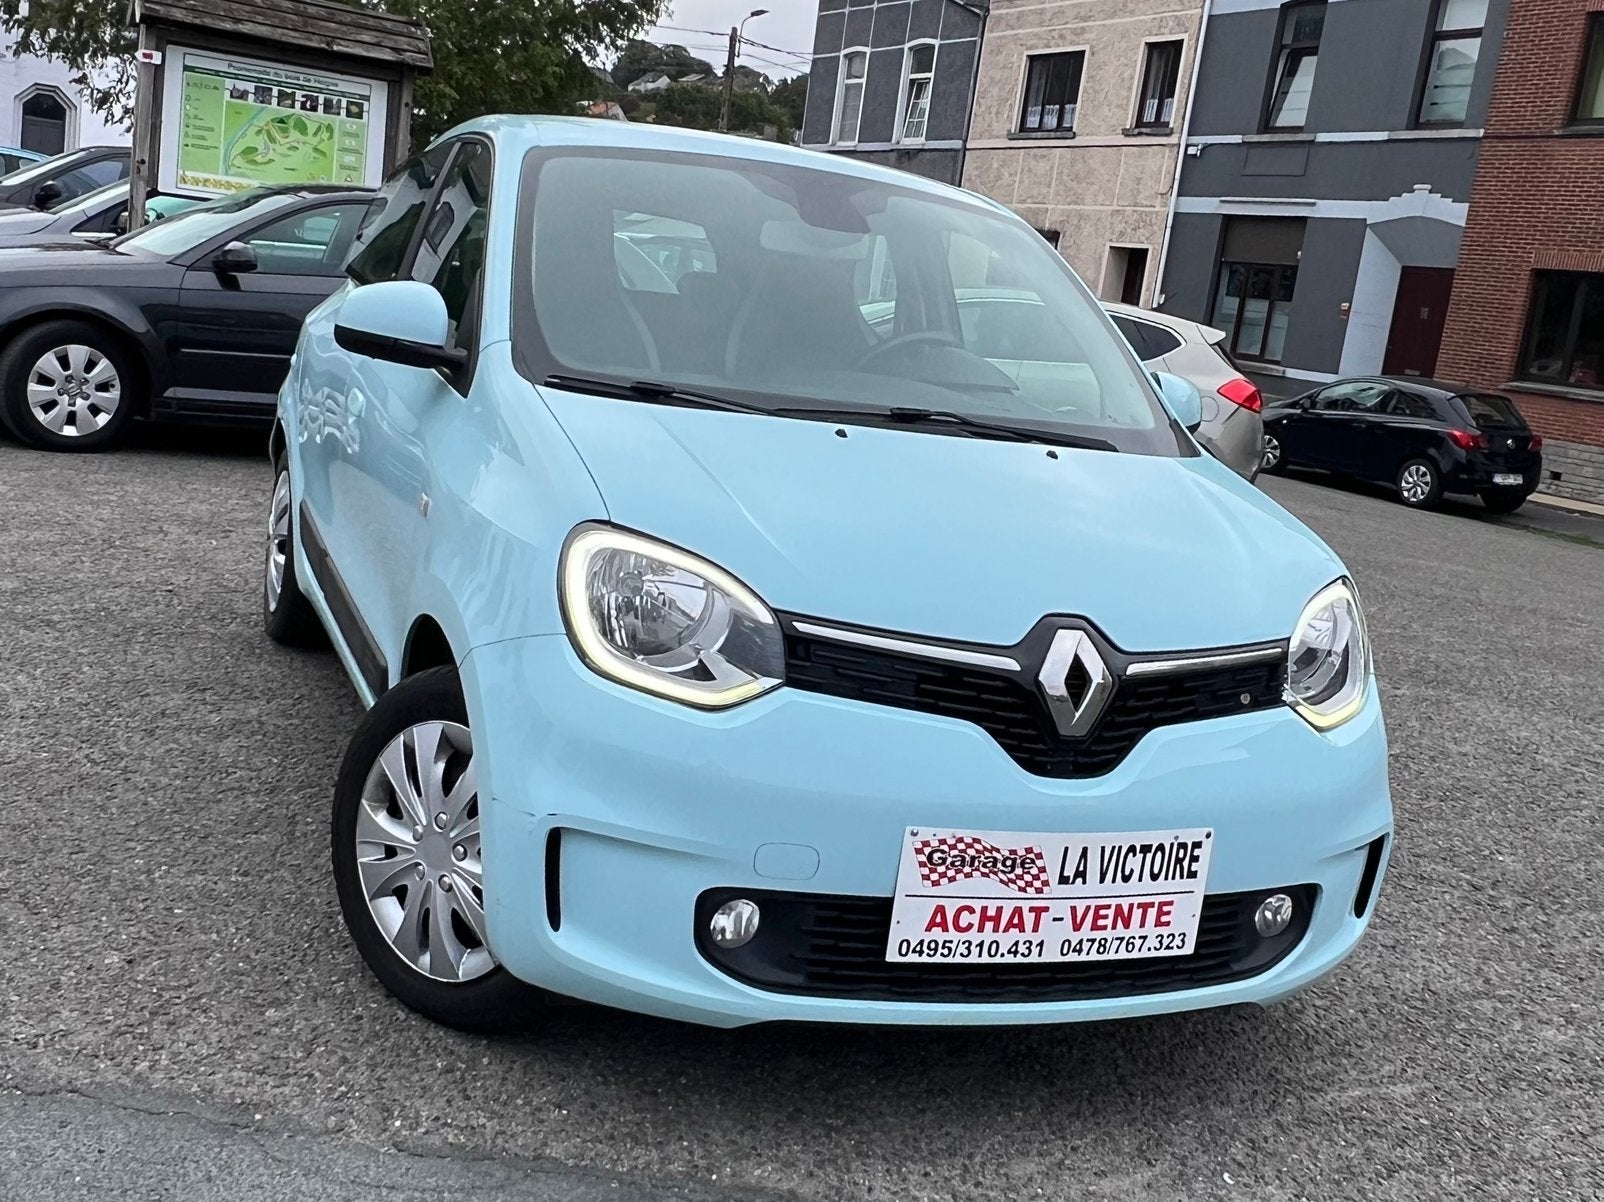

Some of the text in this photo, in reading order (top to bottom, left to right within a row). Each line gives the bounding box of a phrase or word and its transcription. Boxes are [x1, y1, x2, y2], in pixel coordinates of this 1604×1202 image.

[927, 840, 1203, 886] Garage LA VICTOIRE
[924, 900, 1175, 934] ACHAT-VENTE
[897, 932, 1188, 960] 0495/310.431 0478/767.323
